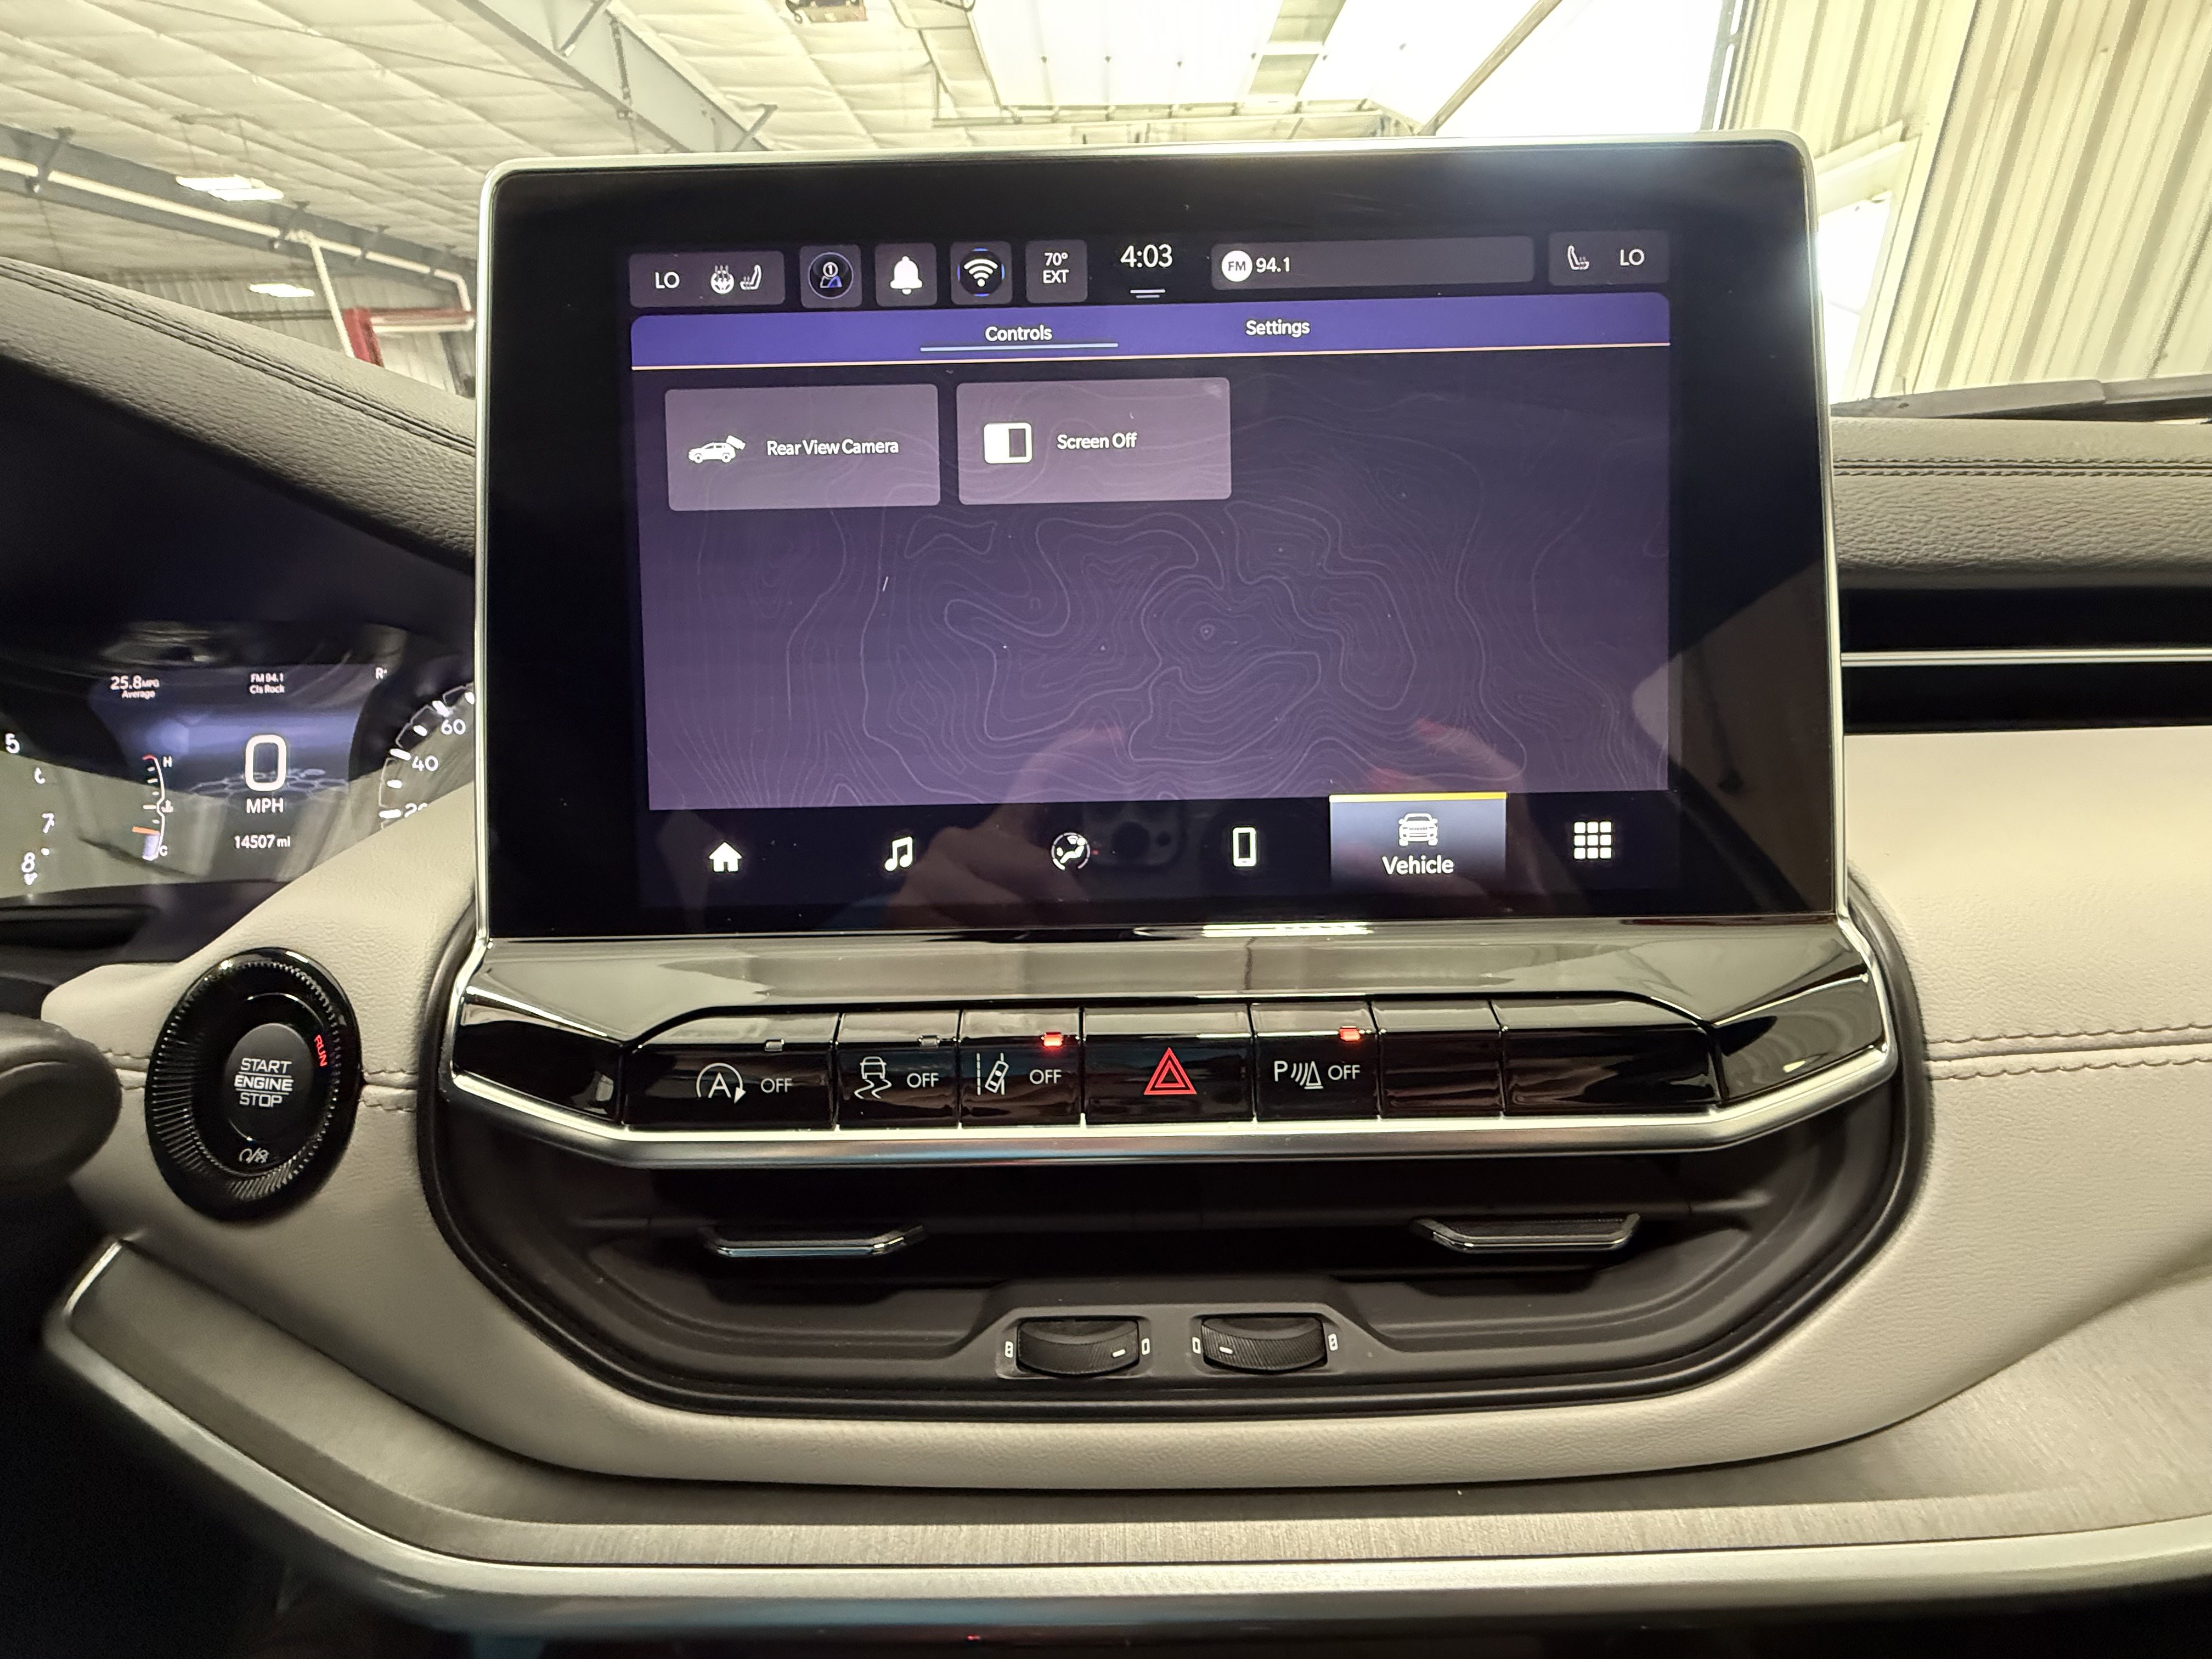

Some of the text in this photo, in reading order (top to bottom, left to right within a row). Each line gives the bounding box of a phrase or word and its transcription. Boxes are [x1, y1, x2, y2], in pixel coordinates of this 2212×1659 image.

[1043, 252, 1068, 266] 70°
[1120, 244, 1172, 268] 4:03
[1620, 249, 1645, 266] LO
[1227, 257, 1290, 273] FM 94.1
[655, 272, 680, 289] LO
[1043, 269, 1069, 284] EXT
[985, 323, 1053, 342] Controls
[1245, 319, 1311, 338] Settings
[767, 438, 899, 456] Rear View Camera
[1057, 432, 1138, 449] Screen Off
[250, 673, 264, 683] FM
[121, 690, 156, 699] Average
[264, 684, 285, 693] Rock
[441, 719, 466, 735] 60
[4, 733, 20, 754] 5
[163, 756, 172, 768] H
[245, 735, 287, 792] 0
[411, 755, 439, 771] 40
[246, 797, 284, 814] MPH
[234, 834, 291, 849] 14507 mi
[21, 852, 36, 873] 8
[1382, 854, 1454, 874] Vehicle
[314, 1035, 328, 1067] RUN
[240, 1057, 292, 1074] START
[1328, 1064, 1361, 1080] OFF
[234, 1074, 295, 1092] ENGINE
[760, 1077, 793, 1093] OFF
[907, 1073, 939, 1088] OFF
[1029, 1069, 1062, 1085] OFF
[239, 1092, 283, 1108] STOP
